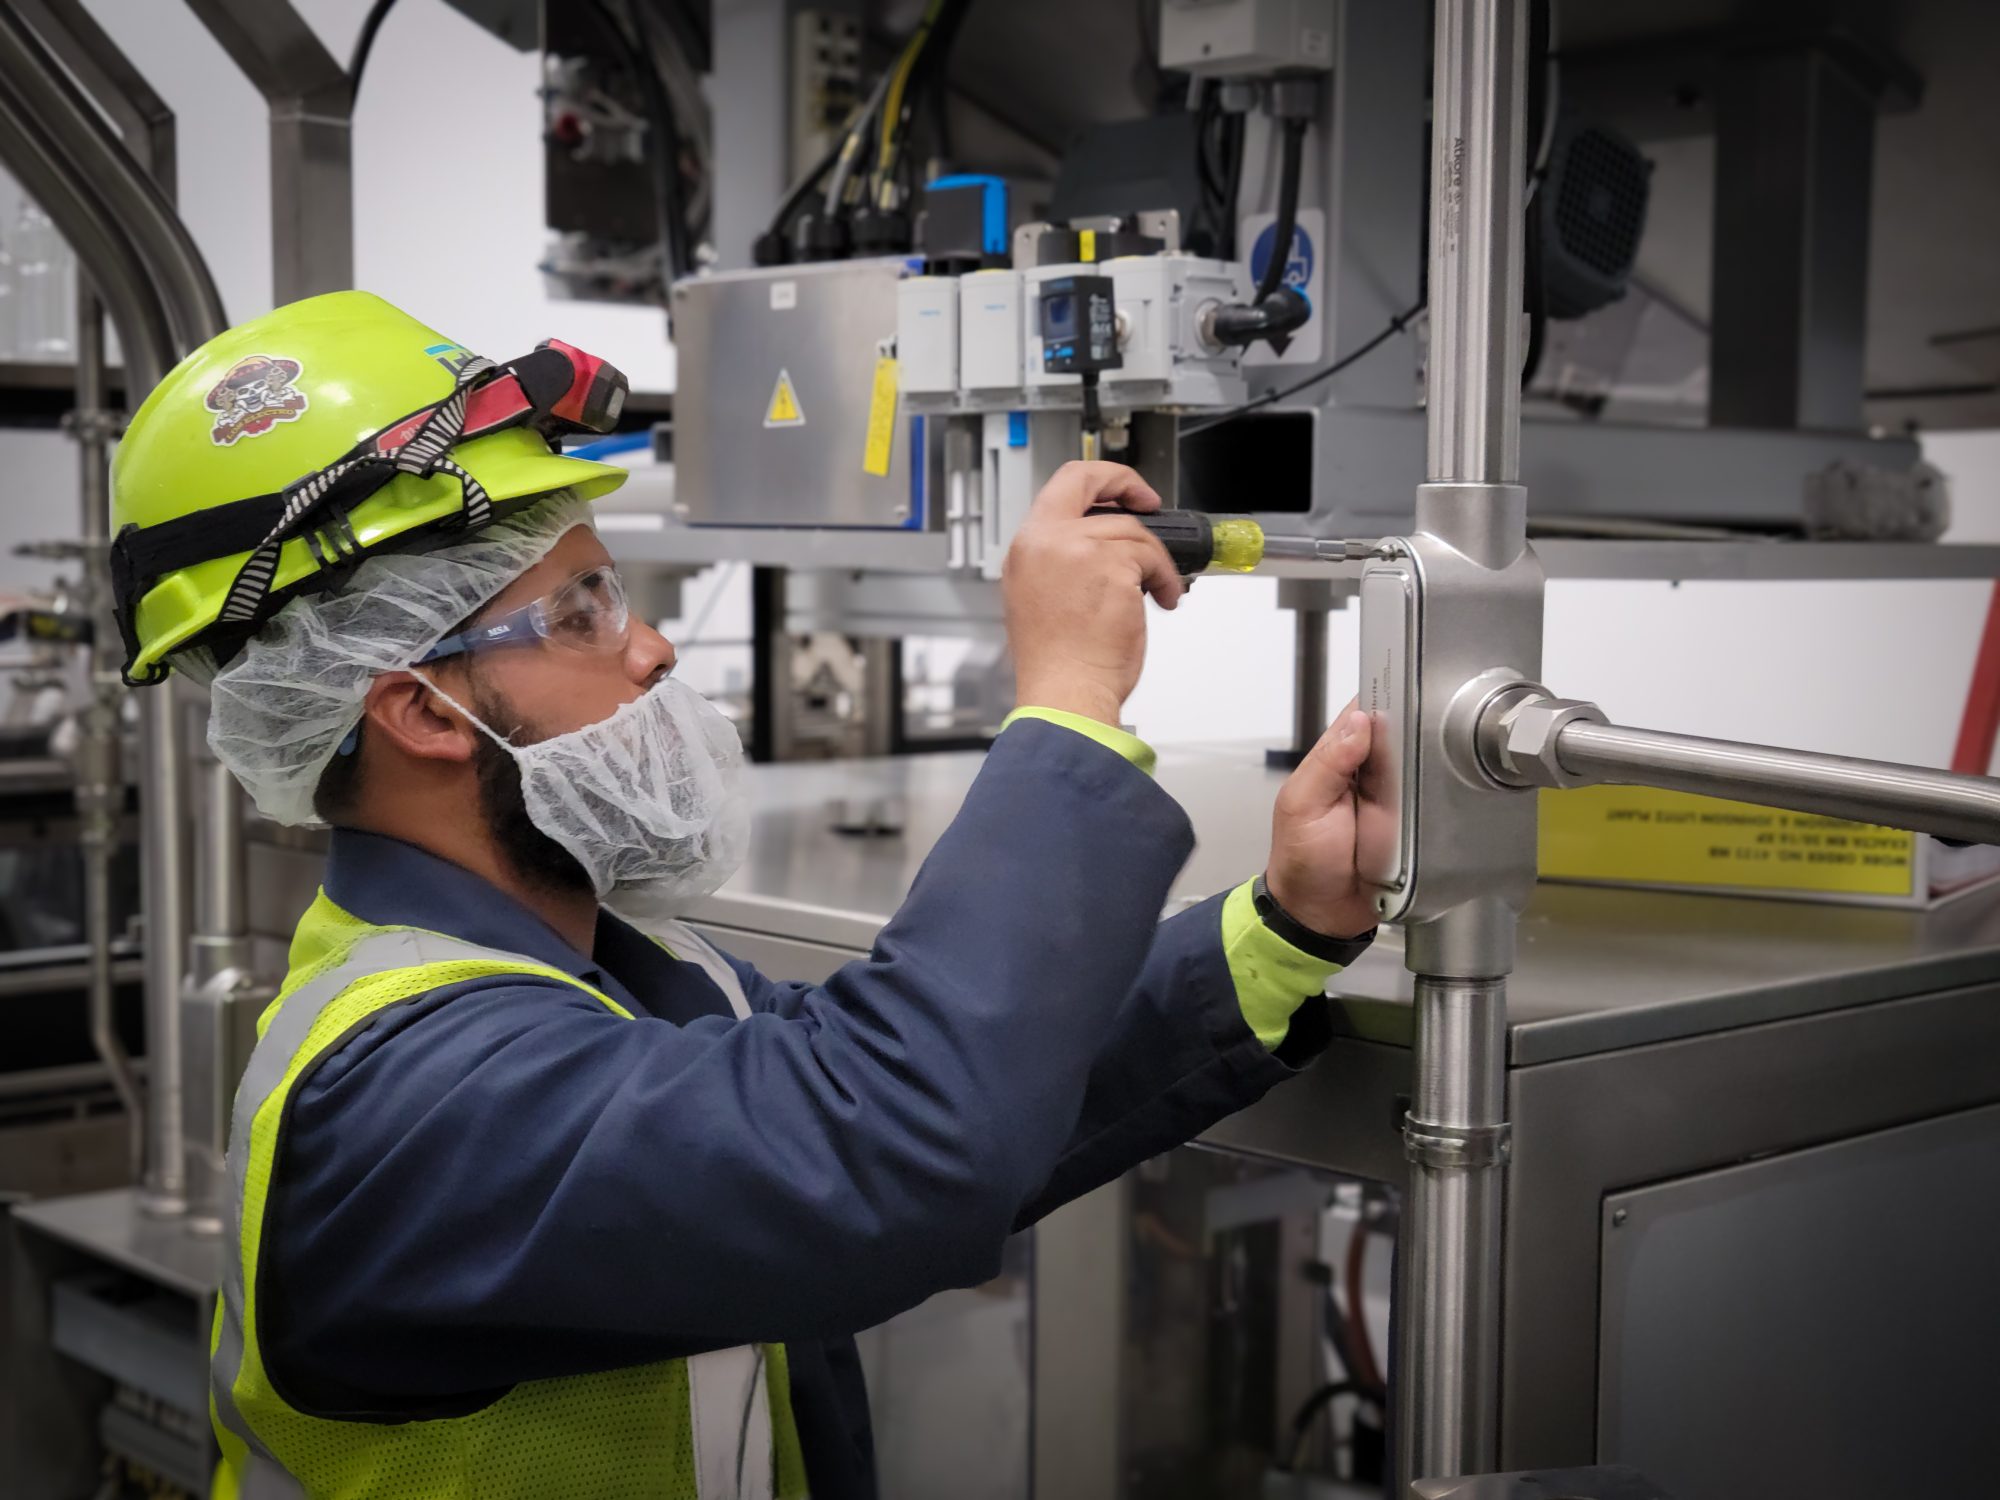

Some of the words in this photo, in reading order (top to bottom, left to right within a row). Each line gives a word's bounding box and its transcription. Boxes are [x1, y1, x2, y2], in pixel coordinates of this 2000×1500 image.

[1453, 137, 1465, 187] Atkore
[487, 624, 511, 637] MSA
[1606, 809, 1651, 822] PLANT
[1808, 852, 1857, 866] ORDER
[1863, 855, 1907, 867] WORK
